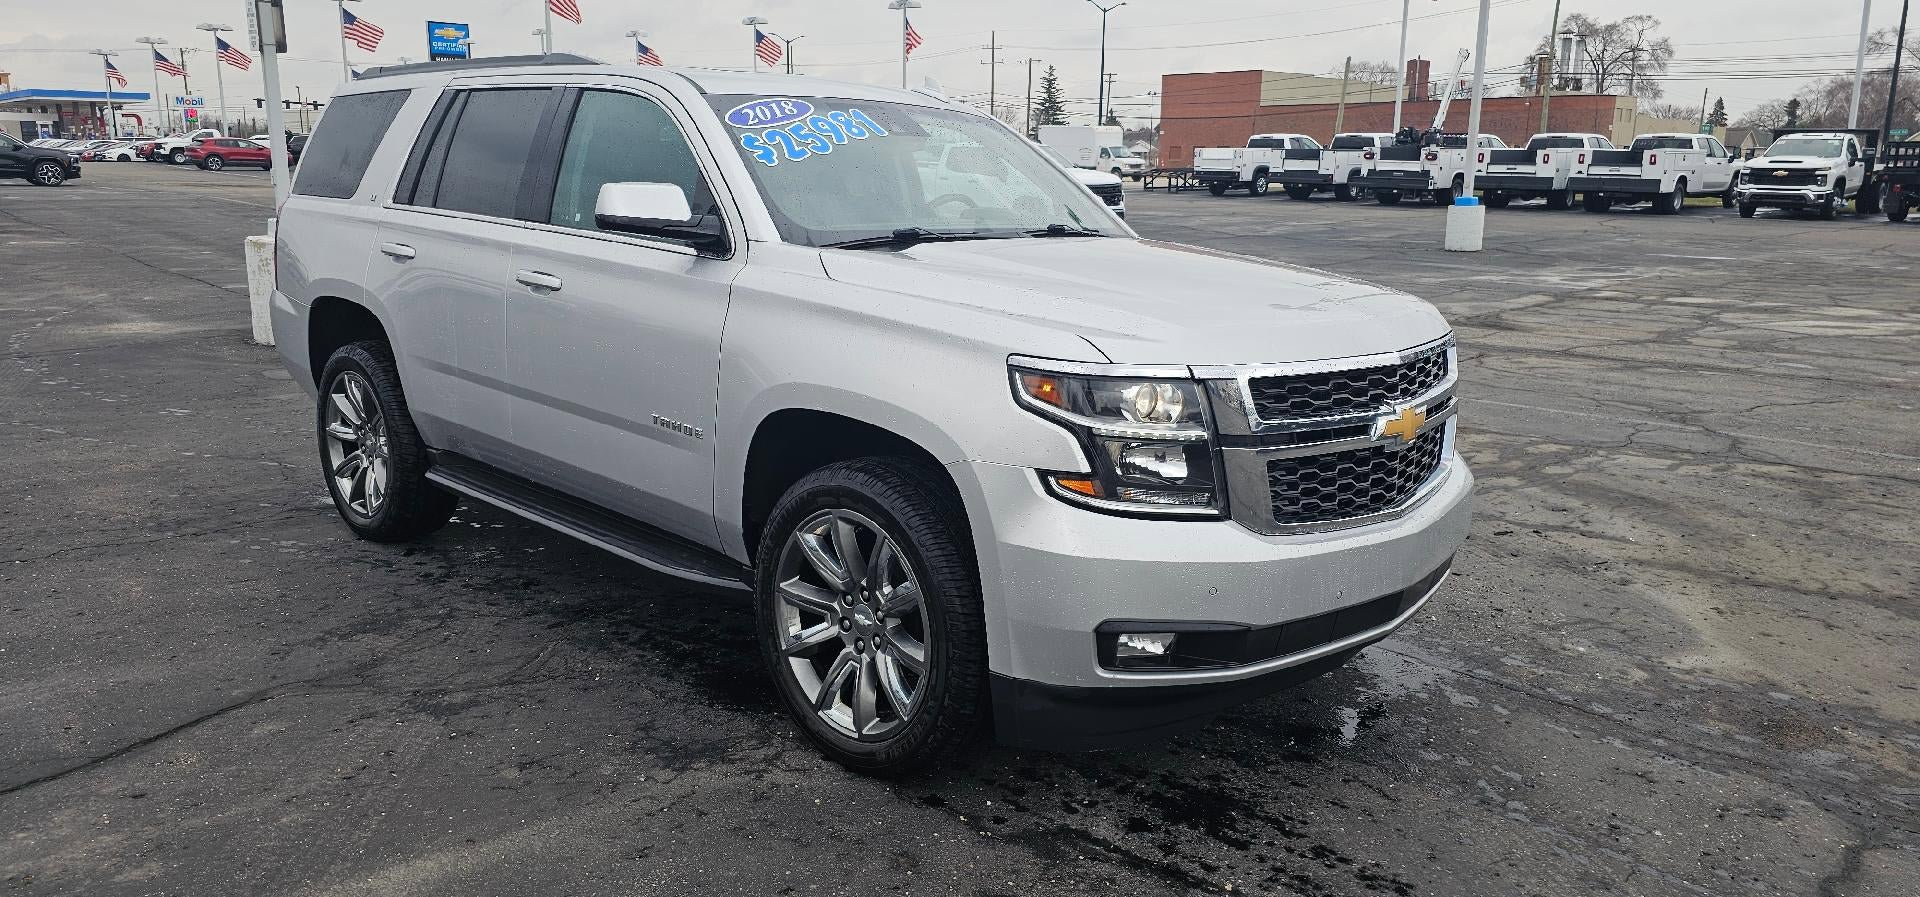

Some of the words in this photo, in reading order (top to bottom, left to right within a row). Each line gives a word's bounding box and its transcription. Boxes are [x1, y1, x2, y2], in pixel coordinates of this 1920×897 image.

[175, 96, 204, 106] Mobil
[741, 100, 798, 126] 2018
[740, 108, 889, 167] $25981
[651, 413, 704, 440] TAHOE
